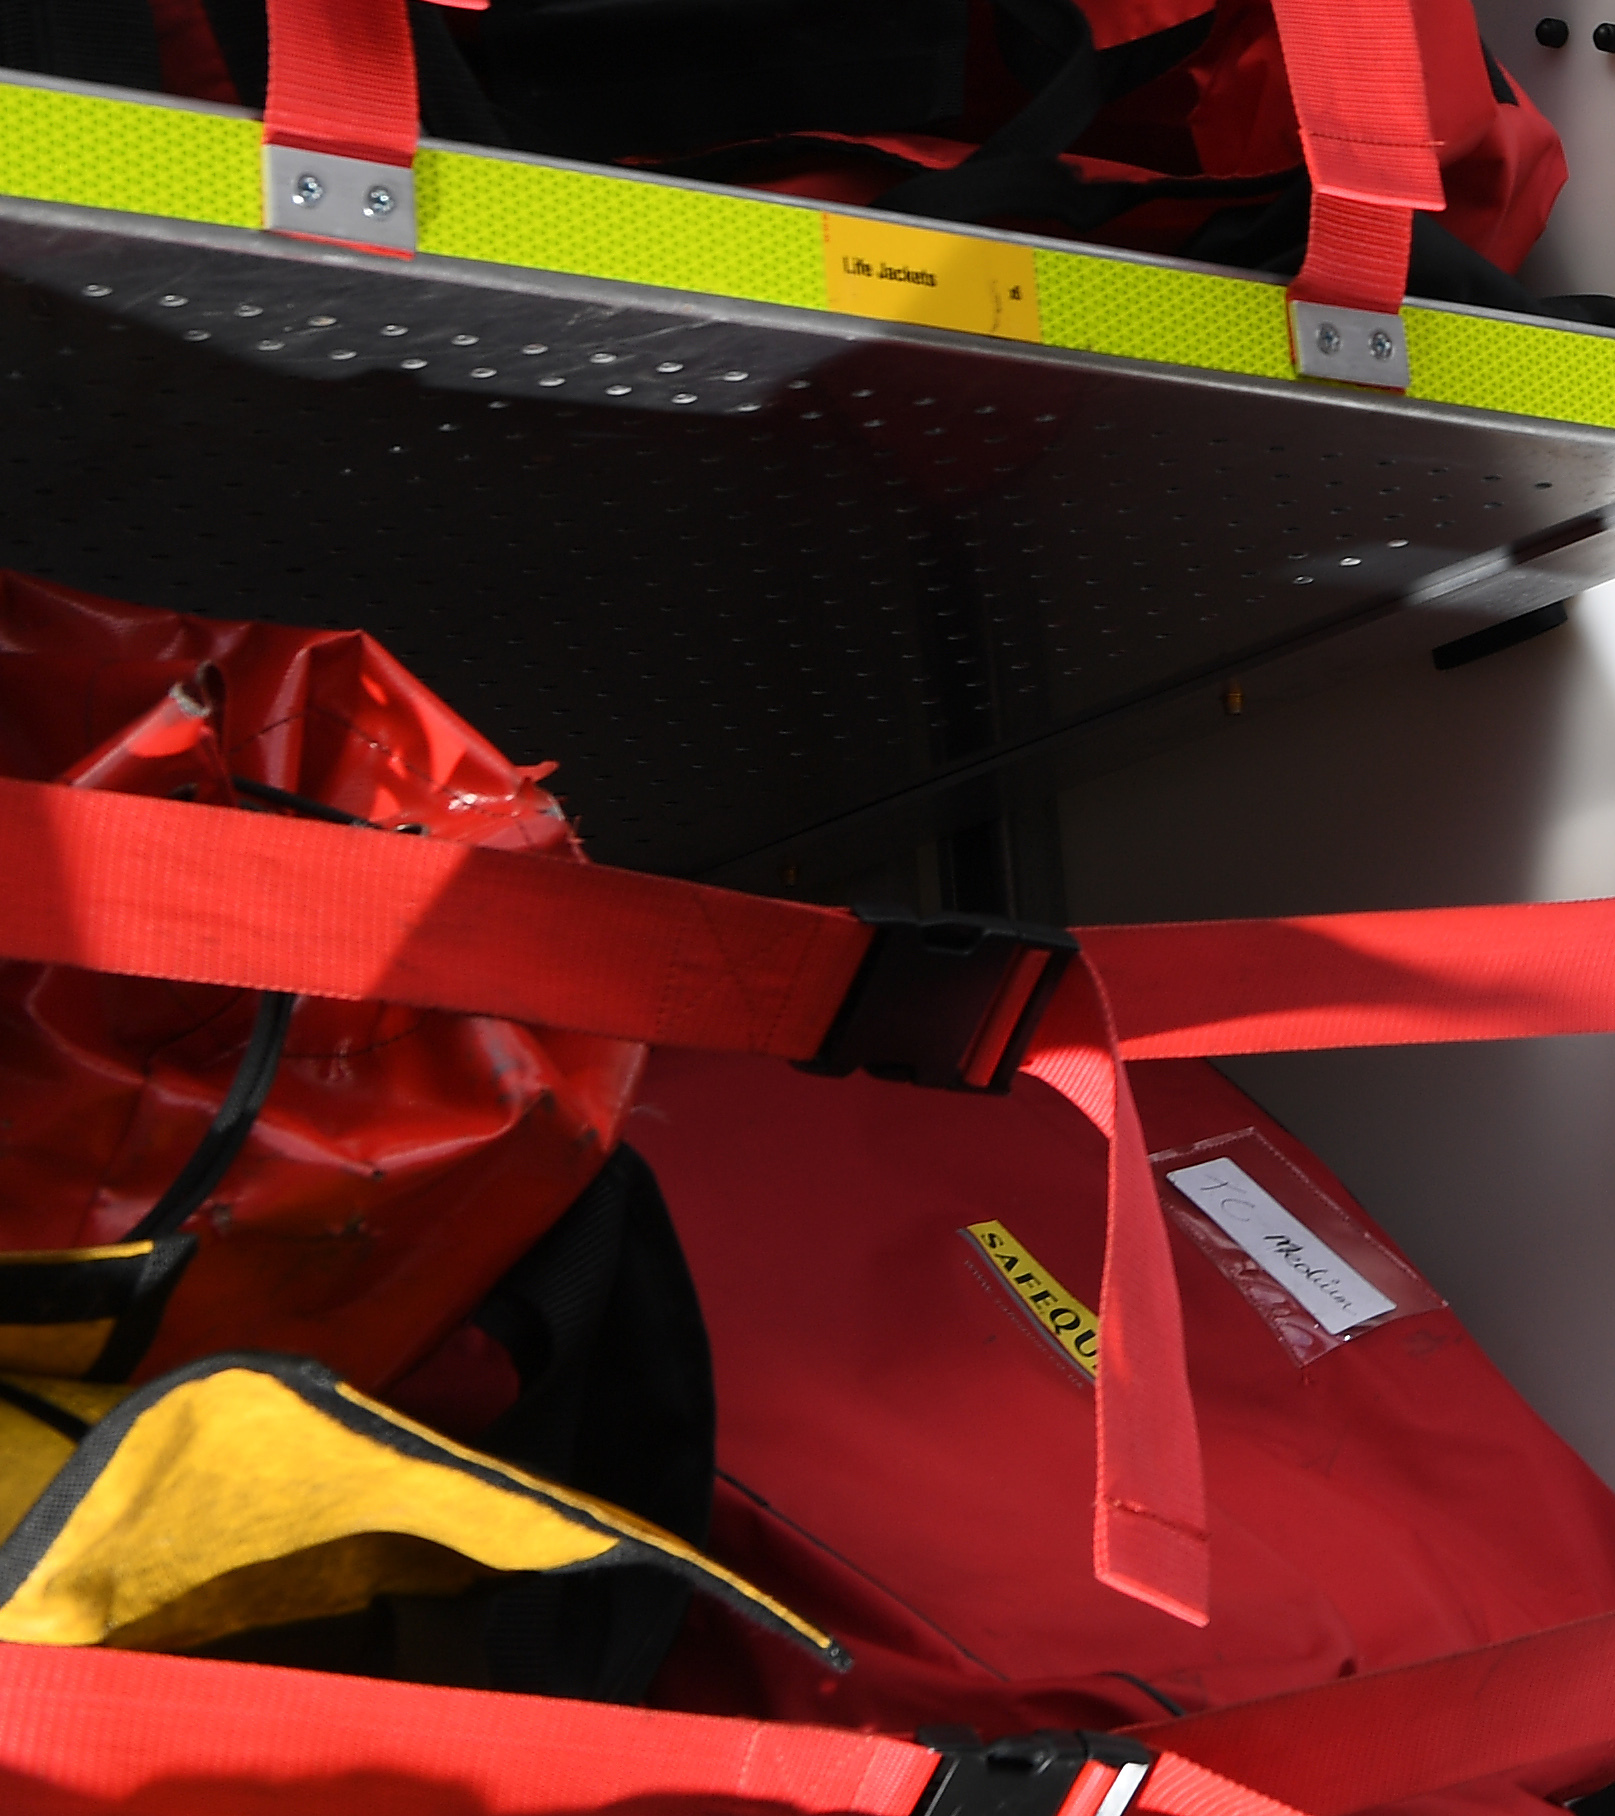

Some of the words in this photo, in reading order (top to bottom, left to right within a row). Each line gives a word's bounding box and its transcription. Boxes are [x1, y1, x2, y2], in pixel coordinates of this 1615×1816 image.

[842, 256, 873, 277] Life
[876, 261, 938, 288] Jackets
[981, 1232, 1098, 1366] SAFEQU
